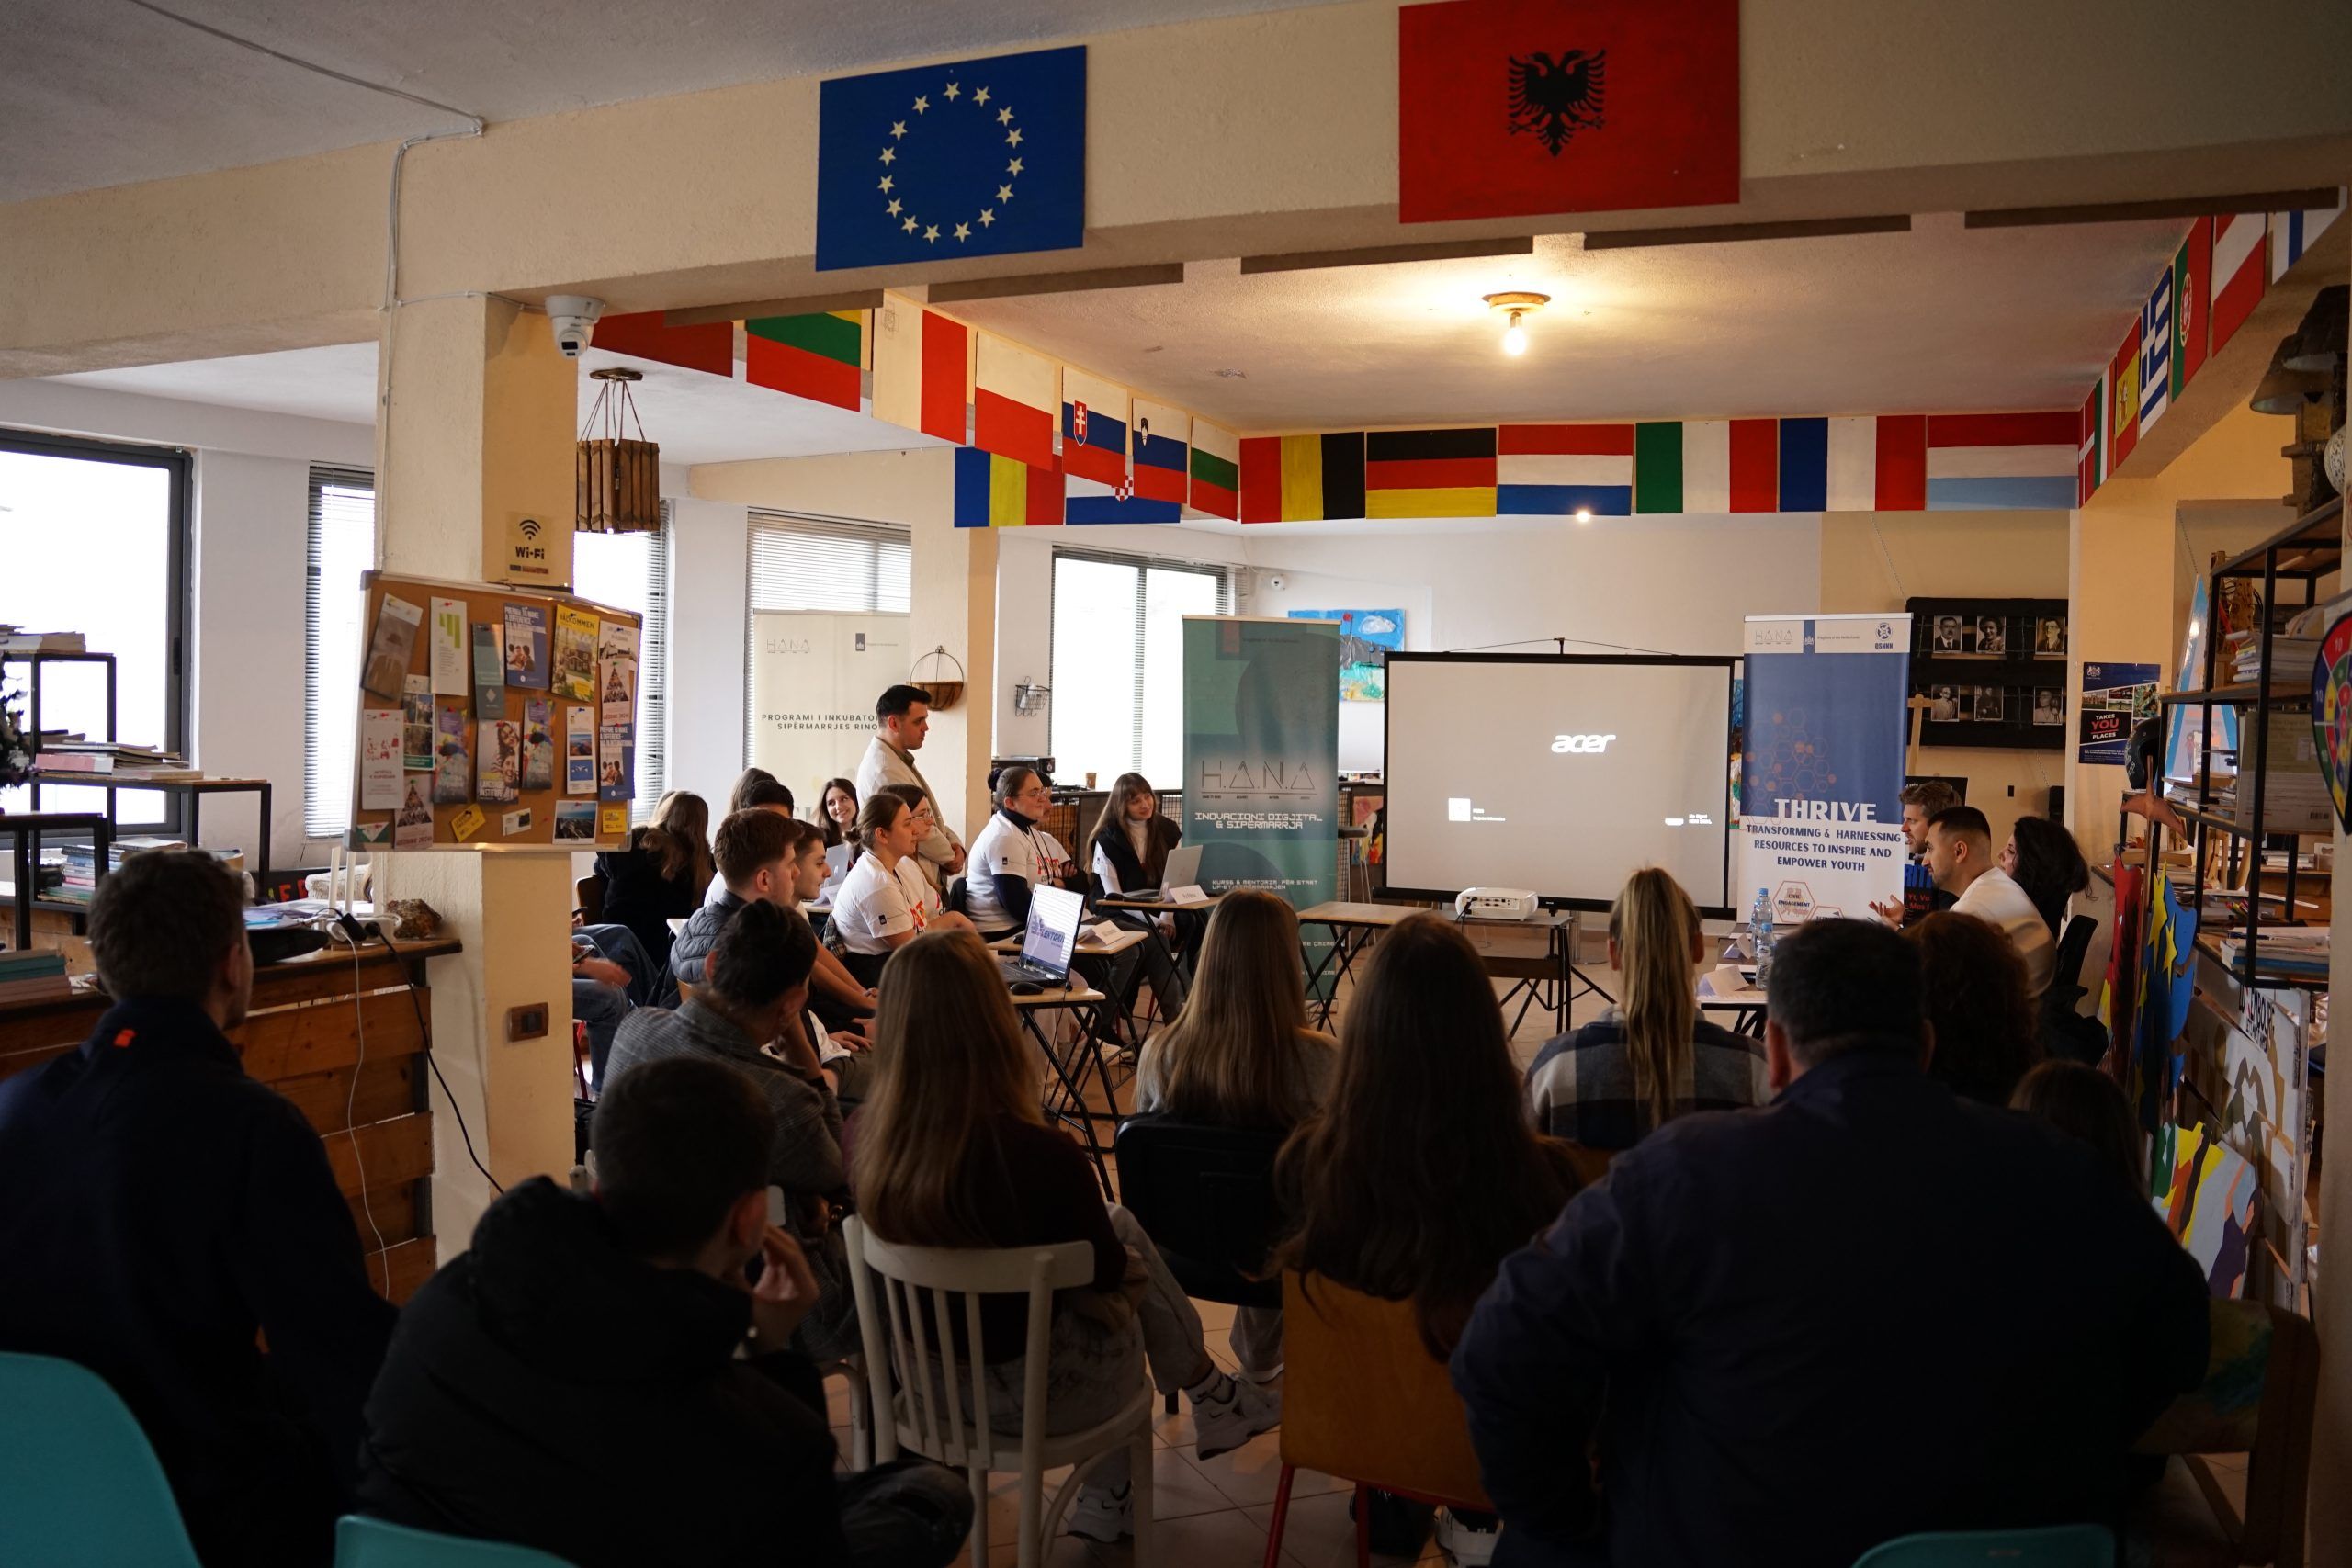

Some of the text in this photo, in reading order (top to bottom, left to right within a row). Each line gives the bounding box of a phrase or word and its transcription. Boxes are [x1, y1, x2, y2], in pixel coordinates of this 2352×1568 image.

[762, 714, 814, 722] PROGRAMI
[777, 721, 851, 731] SIPËRMARRJES
[2090, 719, 2120, 730] YOU
[2092, 732, 2117, 740] PLACES
[1551, 734, 1617, 753] acer
[1774, 798, 1878, 824] THRIVE
[1268, 812, 1323, 822] DIGJITAL
[1747, 823, 1901, 842] TRANSFORMING & HARNESSING
[1754, 840, 1892, 858] RESOURCES TO INSPIRE AND
[1777, 856, 1865, 872] EMPOWER YOUTH
[1778, 899, 1811, 908] ENGAGEMENT
